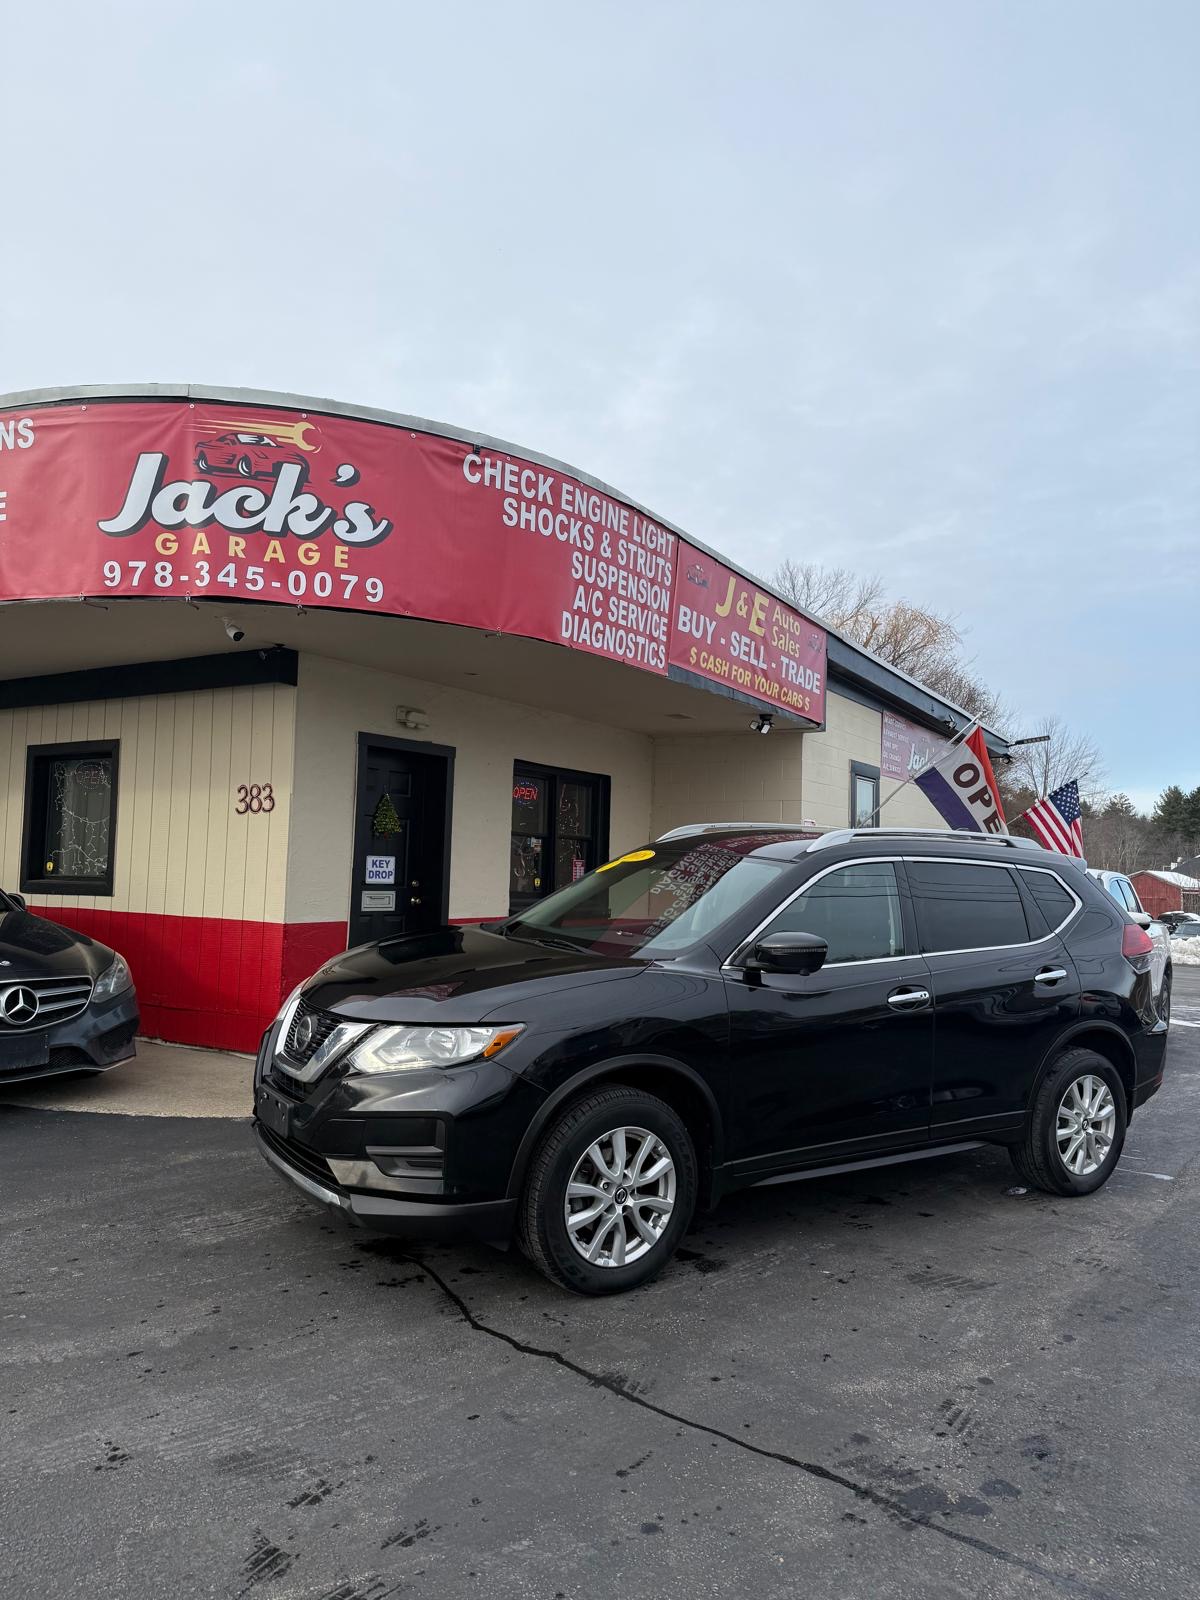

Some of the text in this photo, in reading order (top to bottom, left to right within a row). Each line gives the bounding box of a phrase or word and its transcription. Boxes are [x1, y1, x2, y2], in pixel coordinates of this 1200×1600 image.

[98, 452, 391, 545] Jack's
[462, 453, 675, 558] CHECK ENGINE LIGHT
[154, 532, 349, 569] GARAGE
[502, 498, 672, 587] SHOCKS & STRUTS
[102, 560, 385, 603] 978-345-0079
[571, 551, 670, 614] SUSPENSION
[573, 585, 667, 642] A/C SERVICE
[772, 605, 800, 636] Auto
[561, 611, 666, 669] DIAGNOSTICS
[678, 605, 717, 645] BUY
[730, 631, 768, 670] SELL
[780, 655, 821, 695] TRADE
[771, 626, 800, 658] Sales
[690, 646, 697, 665] $
[700, 652, 730, 677] CASH
[731, 665, 752, 687] FOR
[754, 674, 780, 699] YOUR
[781, 687, 803, 708] CARS
[235, 782, 275, 815] 383
[512, 786, 538, 801] OPEN
[368, 870, 393, 880] DROP
[371, 859, 391, 869] KEY
